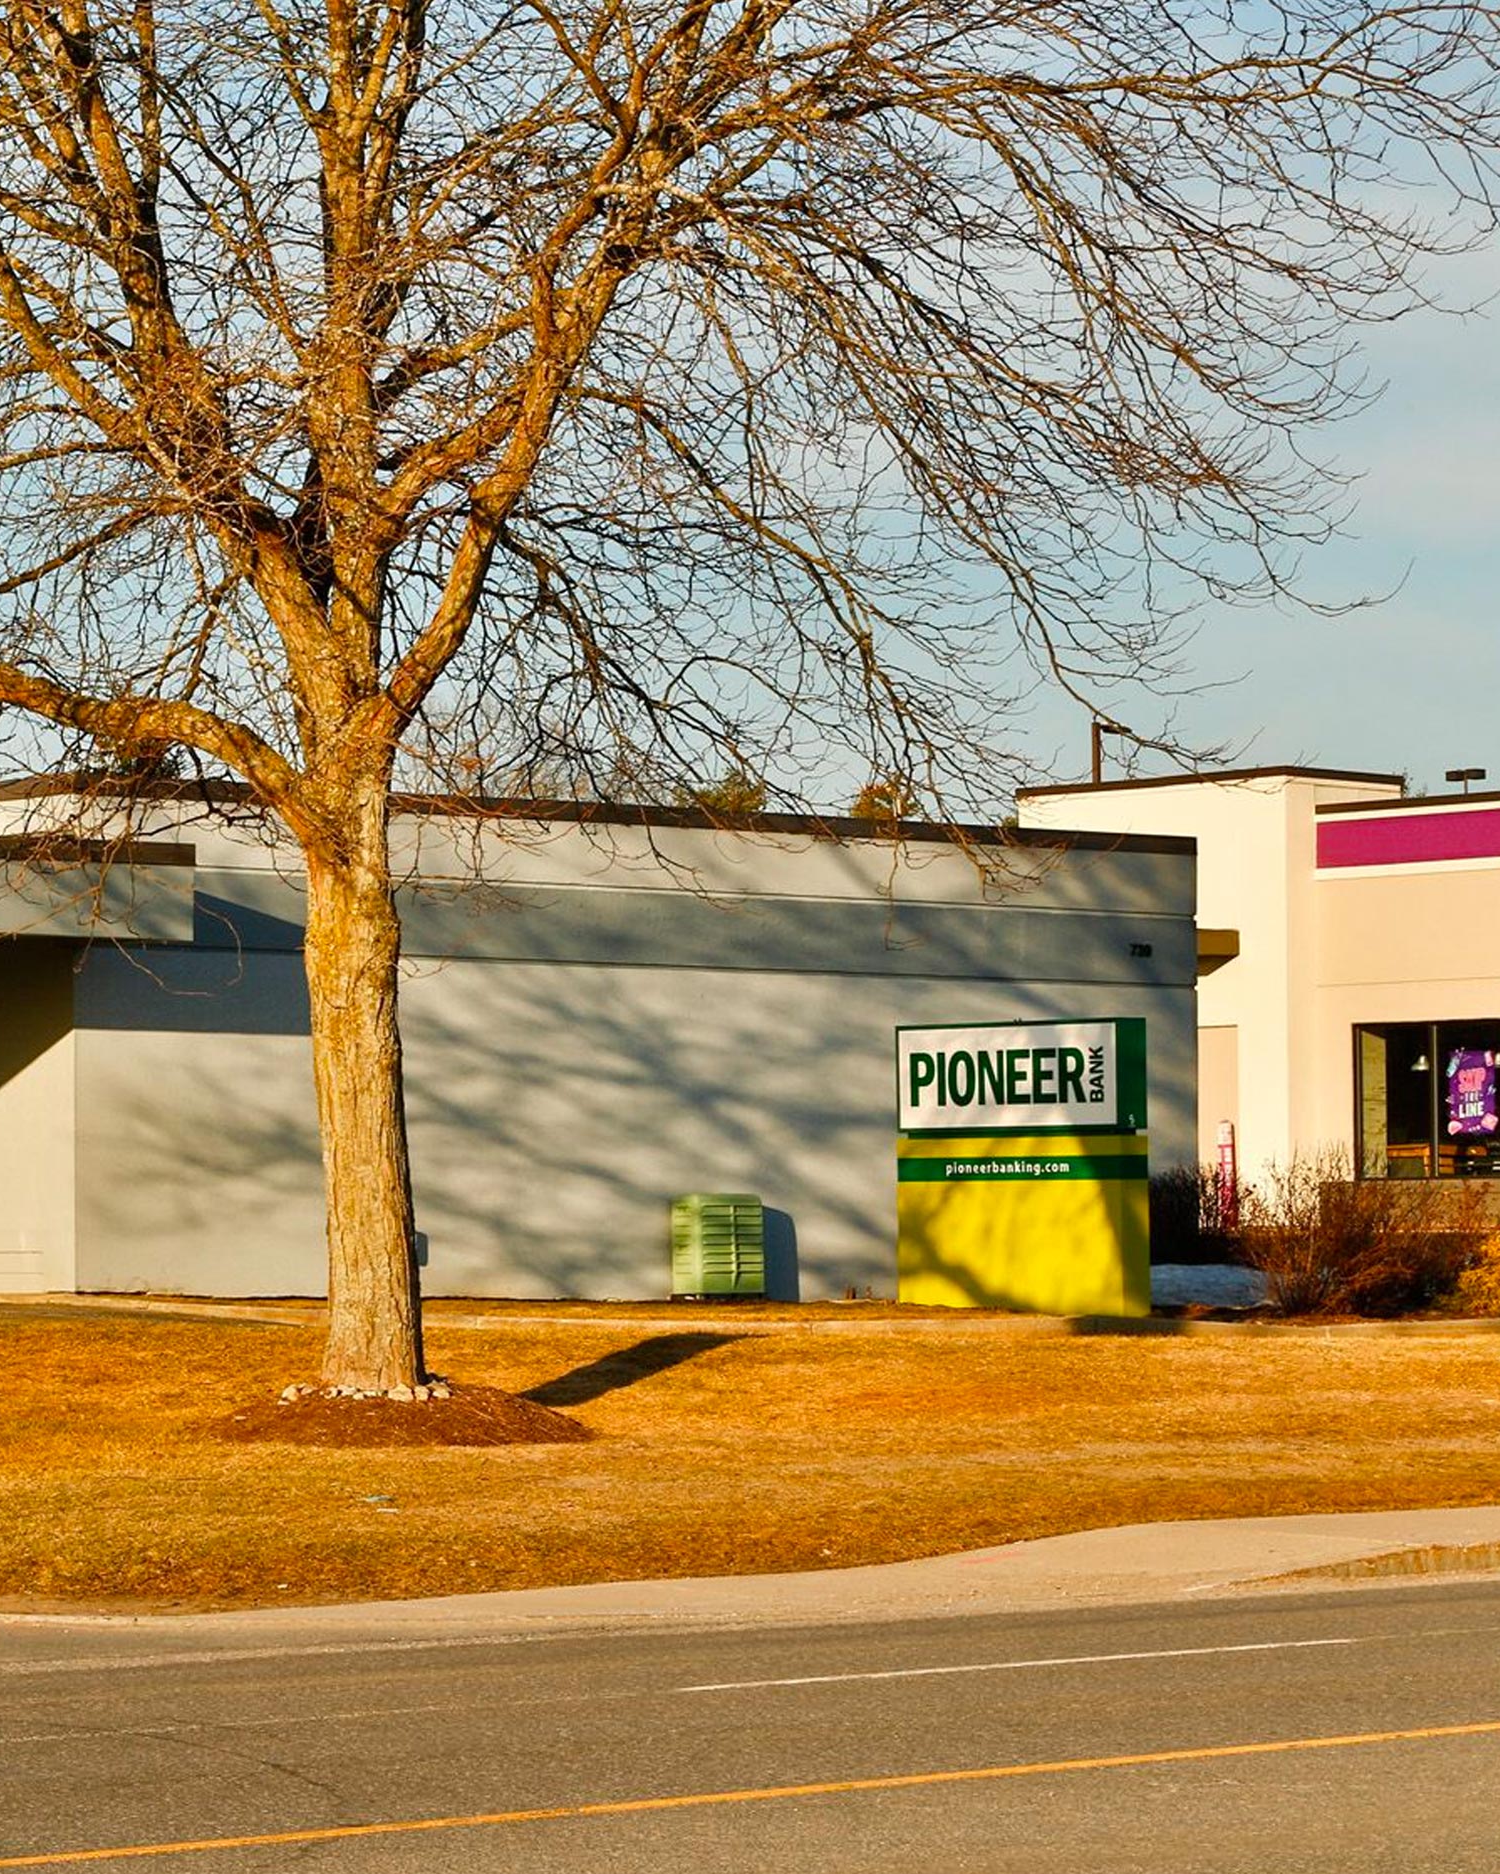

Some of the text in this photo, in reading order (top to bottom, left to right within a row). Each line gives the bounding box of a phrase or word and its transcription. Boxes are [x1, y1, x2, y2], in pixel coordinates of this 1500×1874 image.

[909, 1046, 1088, 1107] PIONEER
[1088, 1046, 1104, 1103] BANK
[946, 1161, 1070, 1177] pioneerbanking.com
